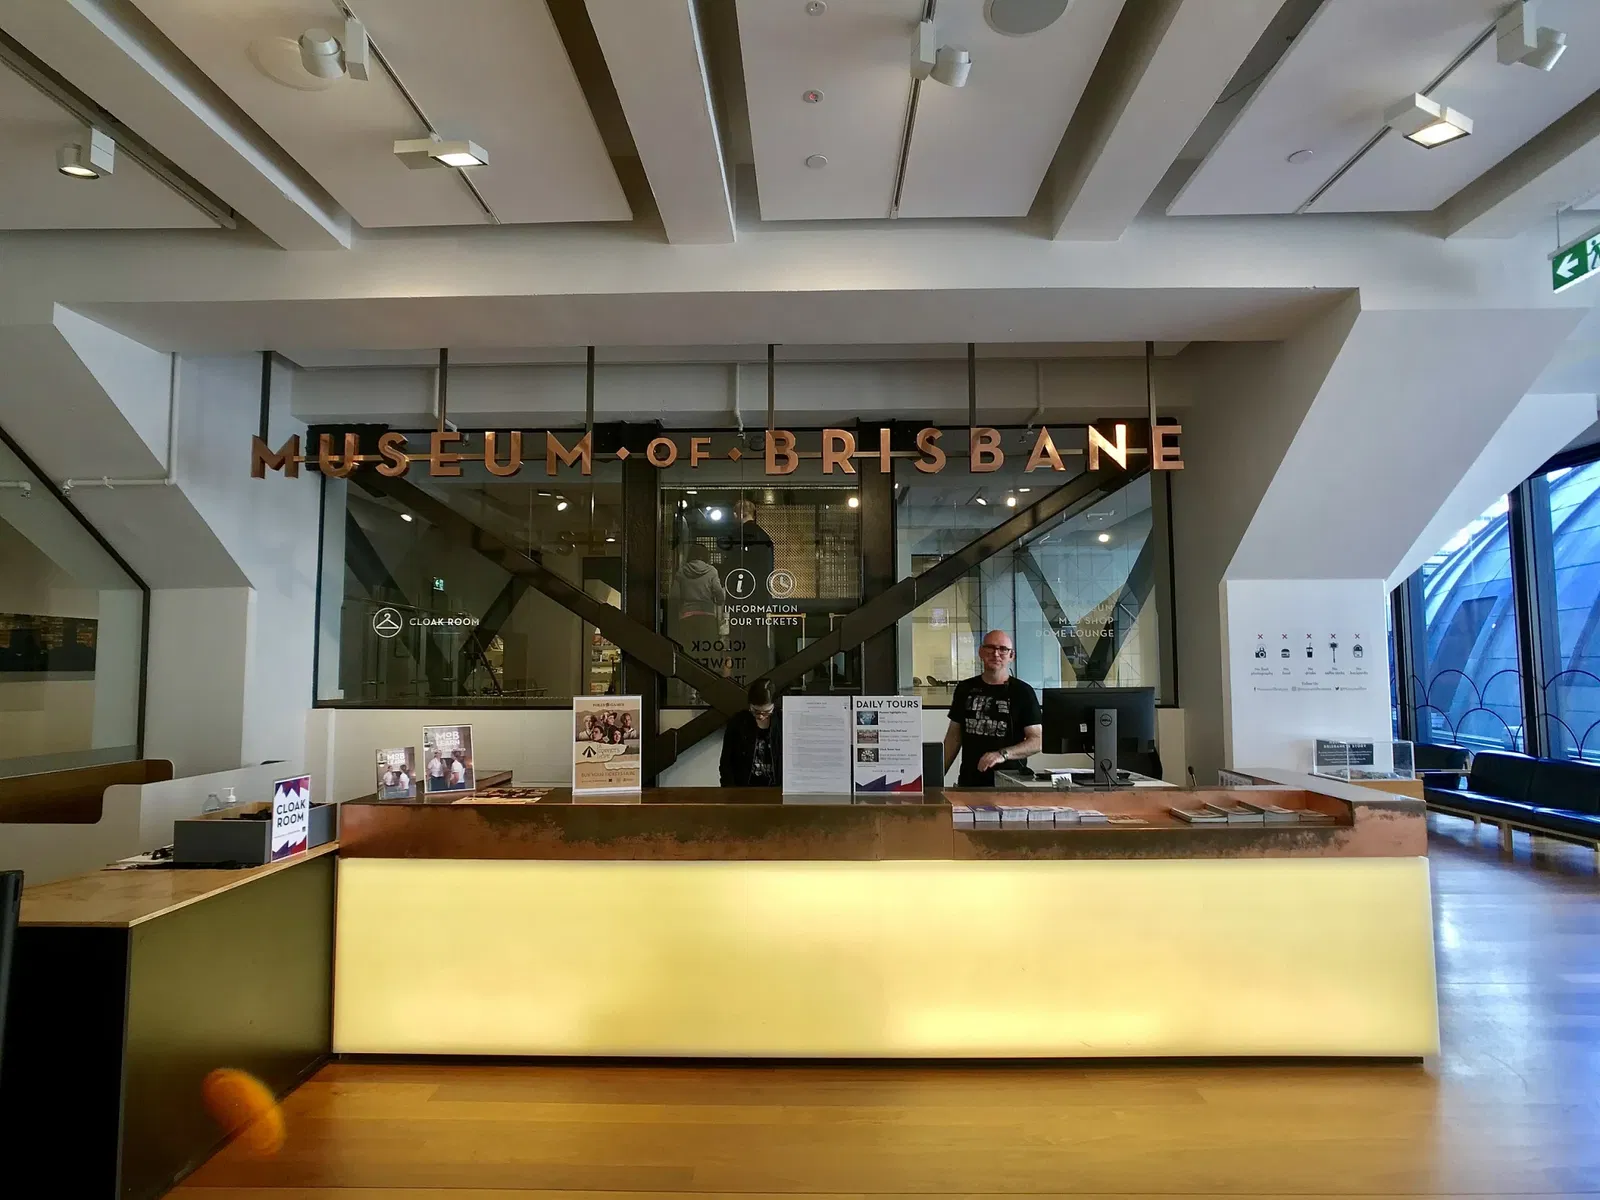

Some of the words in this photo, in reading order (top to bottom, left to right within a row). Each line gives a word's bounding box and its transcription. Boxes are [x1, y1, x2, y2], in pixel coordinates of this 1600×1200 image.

[250, 430, 593, 479] MUSEUM
[647, 437, 711, 468] OF
[765, 424, 1185, 475] BRISBANE
[724, 604, 798, 613] INFORMATION
[409, 618, 444, 626] CLOAK
[447, 618, 480, 626] ROOM
[725, 617, 752, 626] TOUR
[756, 617, 798, 626] TICKETS
[1085, 616, 1114, 625] SHOP
[1036, 629, 1067, 638] DOME
[1070, 629, 1115, 638] LOUNGE
[856, 700, 884, 708] DAILY
[886, 700, 919, 708] TOURS
[276, 799, 306, 815] CLOAK
[277, 813, 304, 828] ROOM
